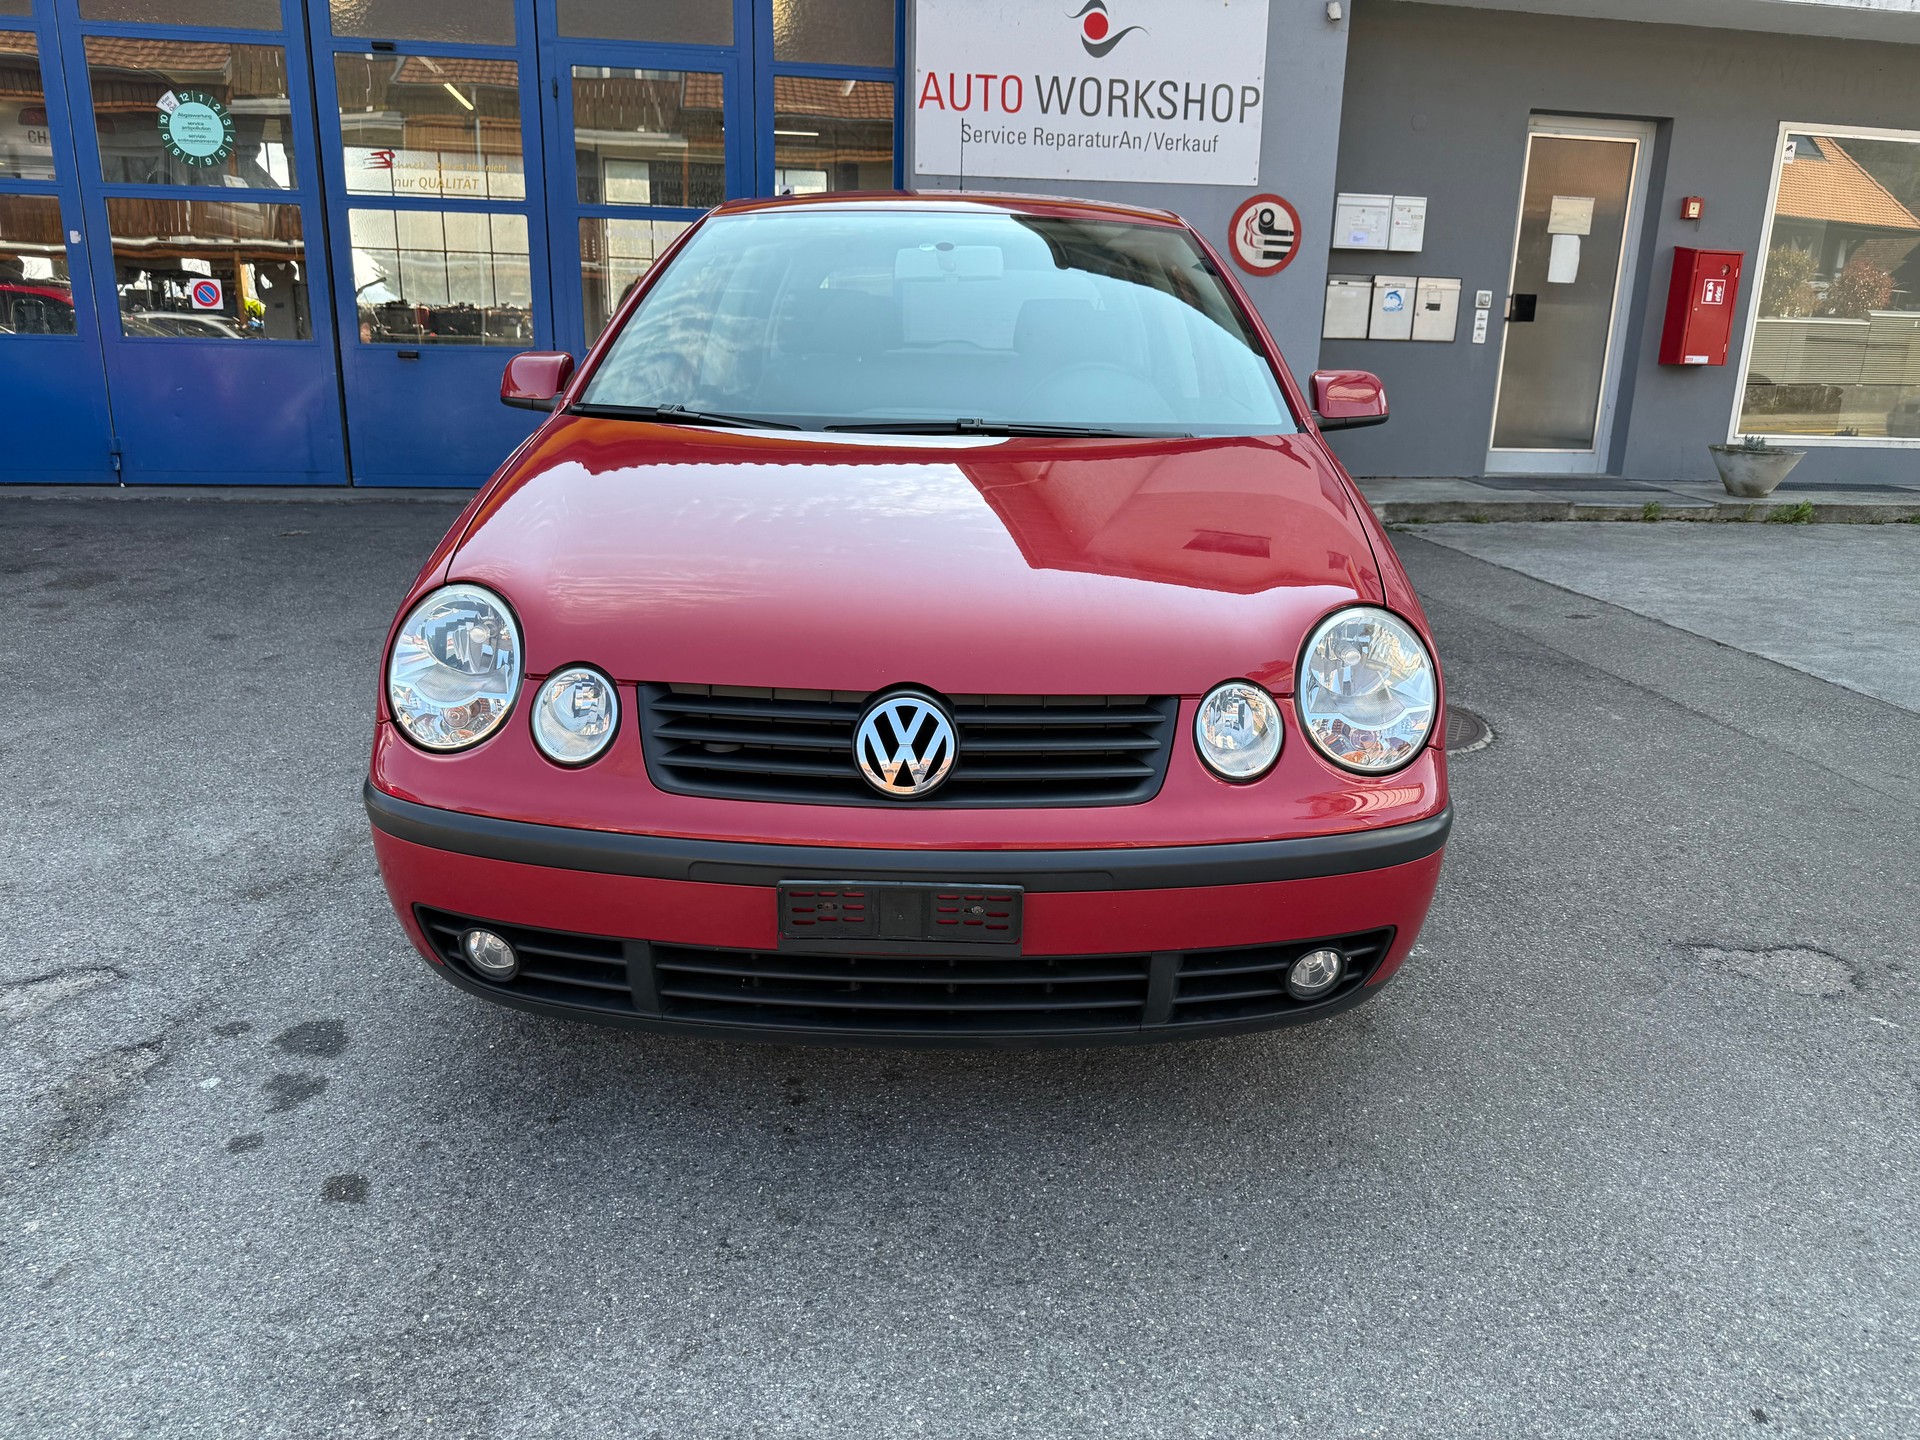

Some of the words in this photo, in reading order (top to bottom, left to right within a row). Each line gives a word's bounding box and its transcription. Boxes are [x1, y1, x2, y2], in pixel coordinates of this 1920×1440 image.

[179, 92, 190, 102] 12
[199, 94, 204, 102] 1
[918, 71, 1023, 114] AUTO
[1034, 74, 1261, 123] WORKSHOP
[213, 103, 221, 112] 2
[159, 114, 169, 124] 10
[223, 118, 232, 126] 3
[962, 123, 1027, 145] Service
[225, 135, 234, 143] 4
[172, 147, 181, 156] 8
[218, 149, 227, 158] 5
[188, 156, 194, 165] 7
[205, 157, 212, 165] 6
[394, 177, 415, 188] nur
[418, 175, 480, 190] QUALITÄT
